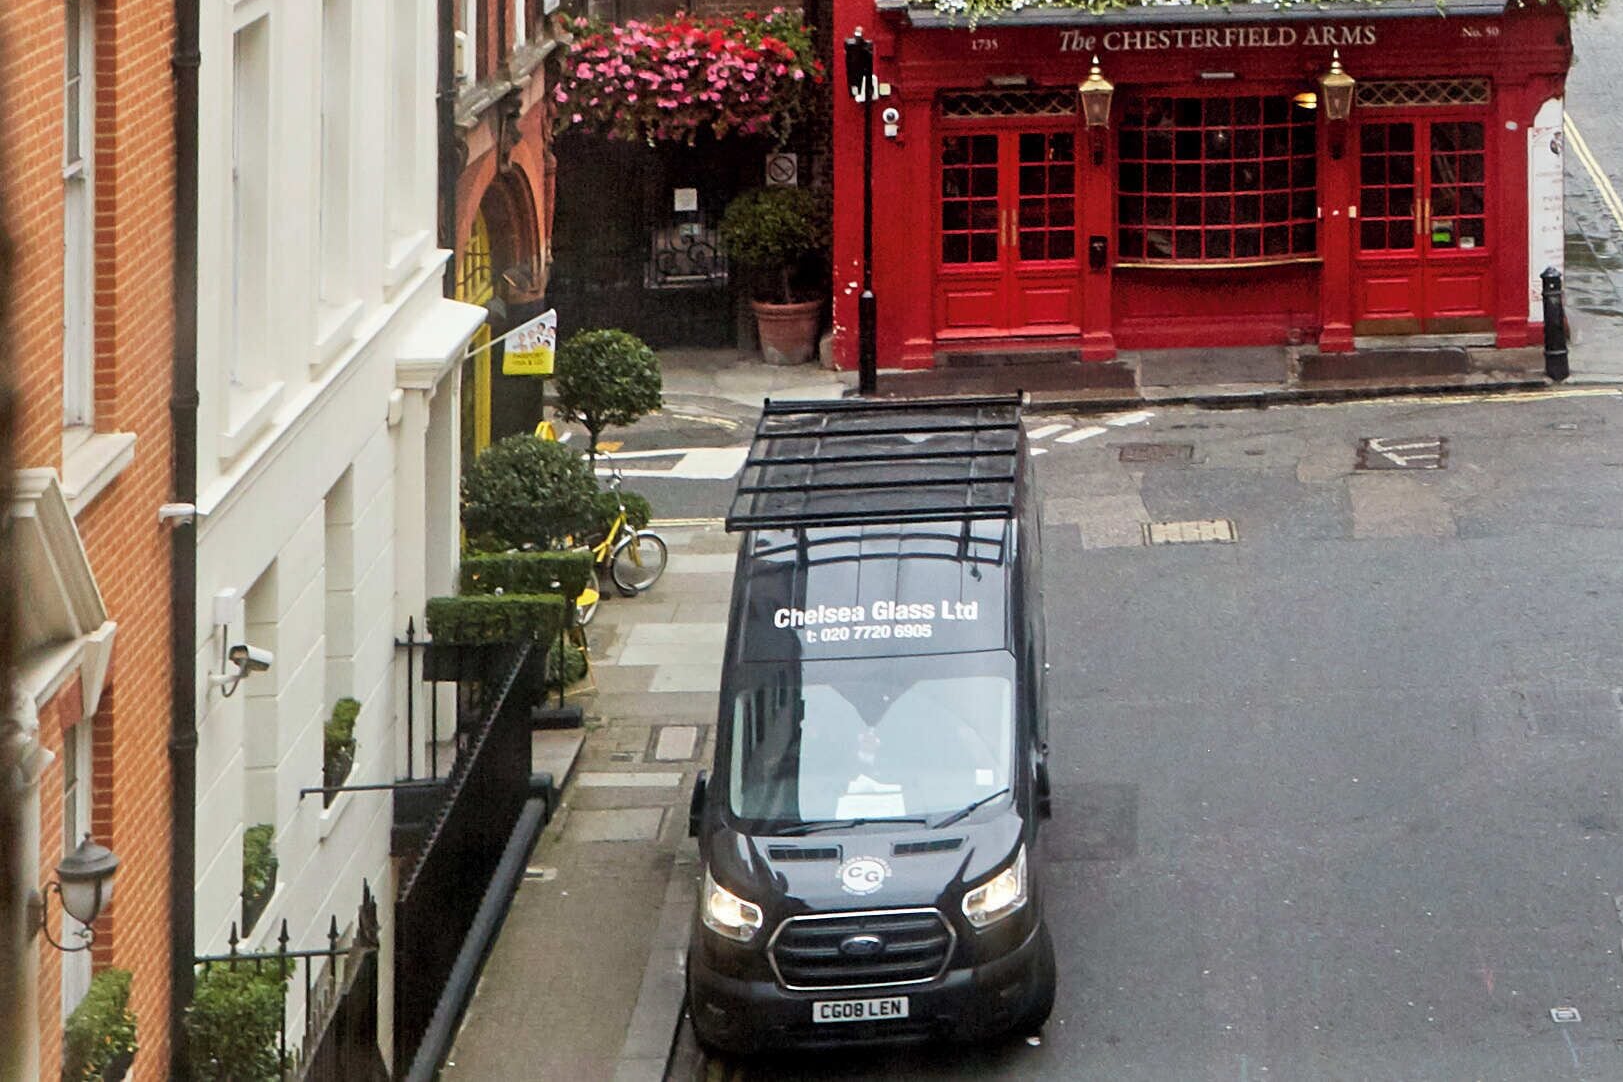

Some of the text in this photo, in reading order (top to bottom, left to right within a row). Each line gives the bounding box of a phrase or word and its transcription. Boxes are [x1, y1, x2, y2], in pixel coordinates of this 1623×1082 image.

[1059, 25, 1376, 51] The CHESTERFIELD ARMS
[774, 600, 979, 629] Chelsea Glass Ltd
[820, 627, 850, 642] 020
[853, 624, 891, 639] 7720
[893, 623, 933, 638] 6905
[820, 999, 901, 1019] CG08 LEN
